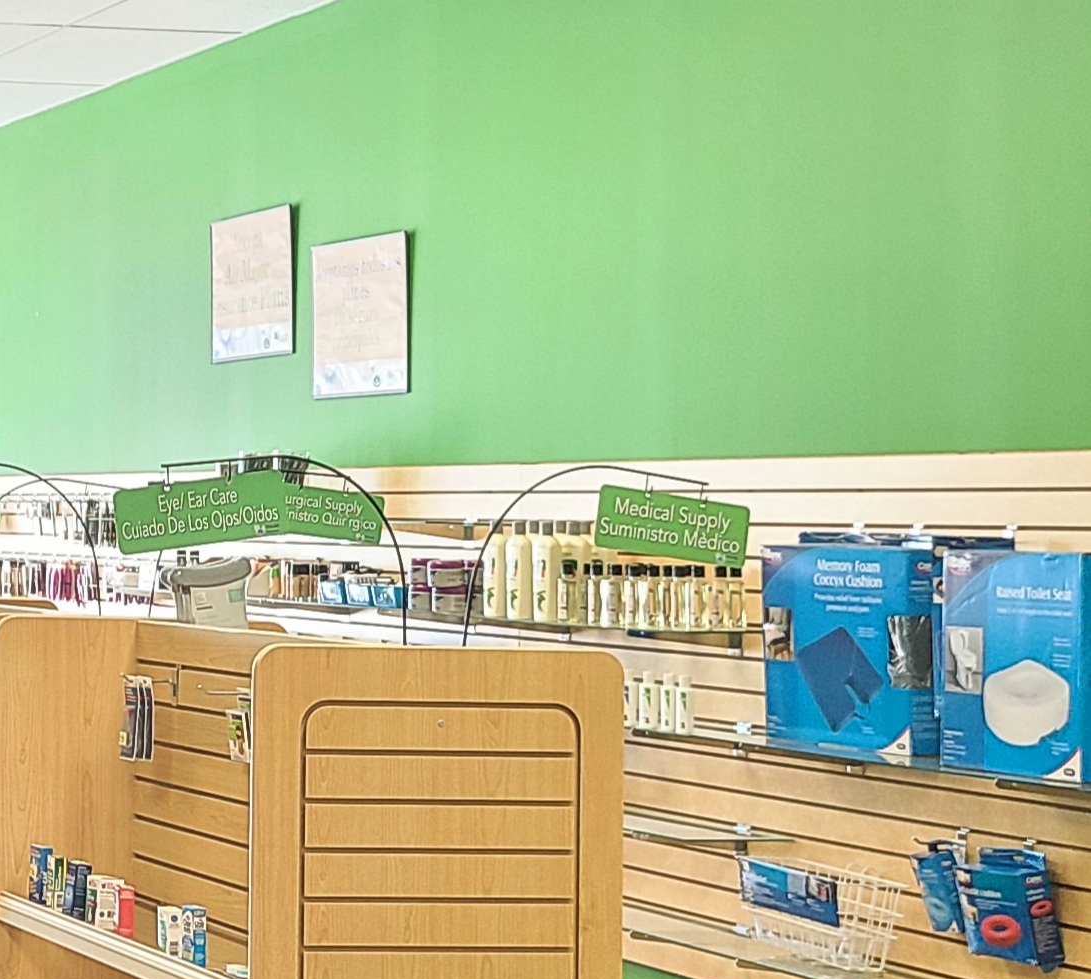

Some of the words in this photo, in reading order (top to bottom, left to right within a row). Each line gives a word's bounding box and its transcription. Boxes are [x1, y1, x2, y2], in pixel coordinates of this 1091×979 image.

[158, 494, 184, 514] Eye/
[188, 491, 207, 509] Ear
[210, 488, 238, 505] Care
[285, 495, 322, 509] urgical
[325, 497, 363, 517] Supply
[122, 520, 164, 541] Cuiado
[168, 517, 186, 534] De
[189, 513, 209, 531] Los
[212, 506, 279, 533] Ojos/Oidos
[322, 512, 376, 532] Quirrgico
[615, 497, 674, 522] Medical
[678, 506, 731, 534] Supply
[599, 517, 679, 545] Suministro
[816, 559, 853, 573] Memory
[855, 560, 880, 573] Foam
[846, 574, 883, 588] Cushion
[1026, 586, 1051, 600] Toilet
[1052, 588, 1072, 600] Seat
